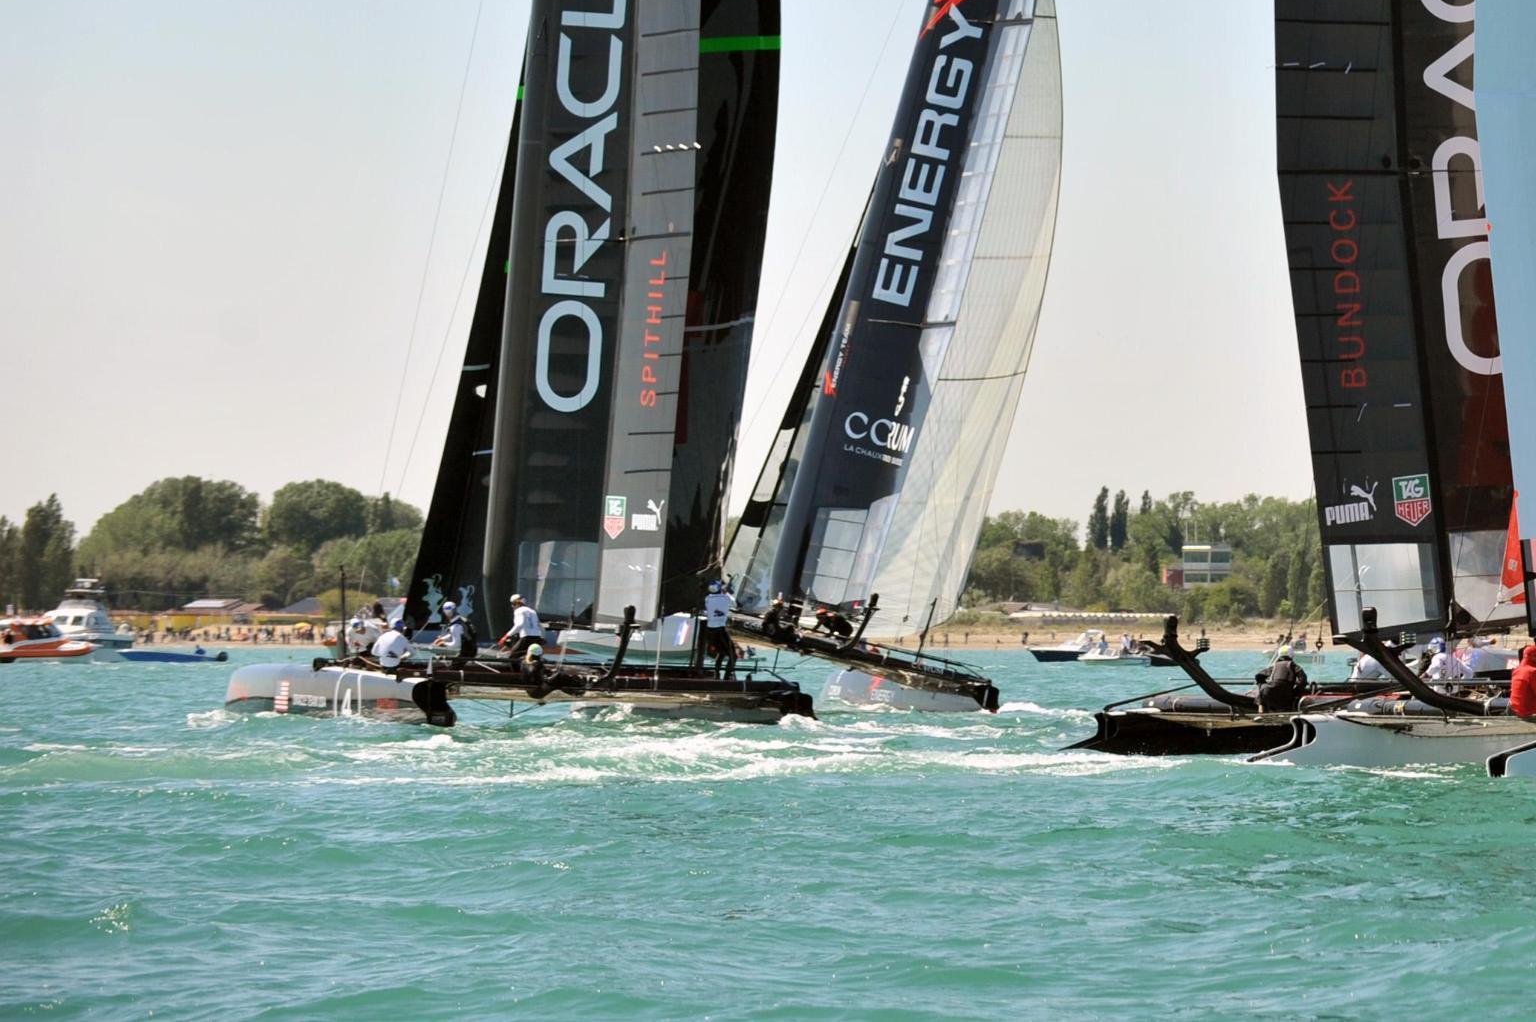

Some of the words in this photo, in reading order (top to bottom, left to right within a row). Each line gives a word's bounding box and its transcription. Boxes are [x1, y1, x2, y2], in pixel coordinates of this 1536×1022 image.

[872, 3, 984, 307] ENERGY
[1326, 179, 1367, 388] BUNDOCK
[640, 250, 667, 408] SPITHILL
[1399, 478, 1424, 499] TAG
[1325, 501, 1370, 526] PUMA
[1397, 500, 1429, 522] HEUER
[341, 688, 352, 716] 4
